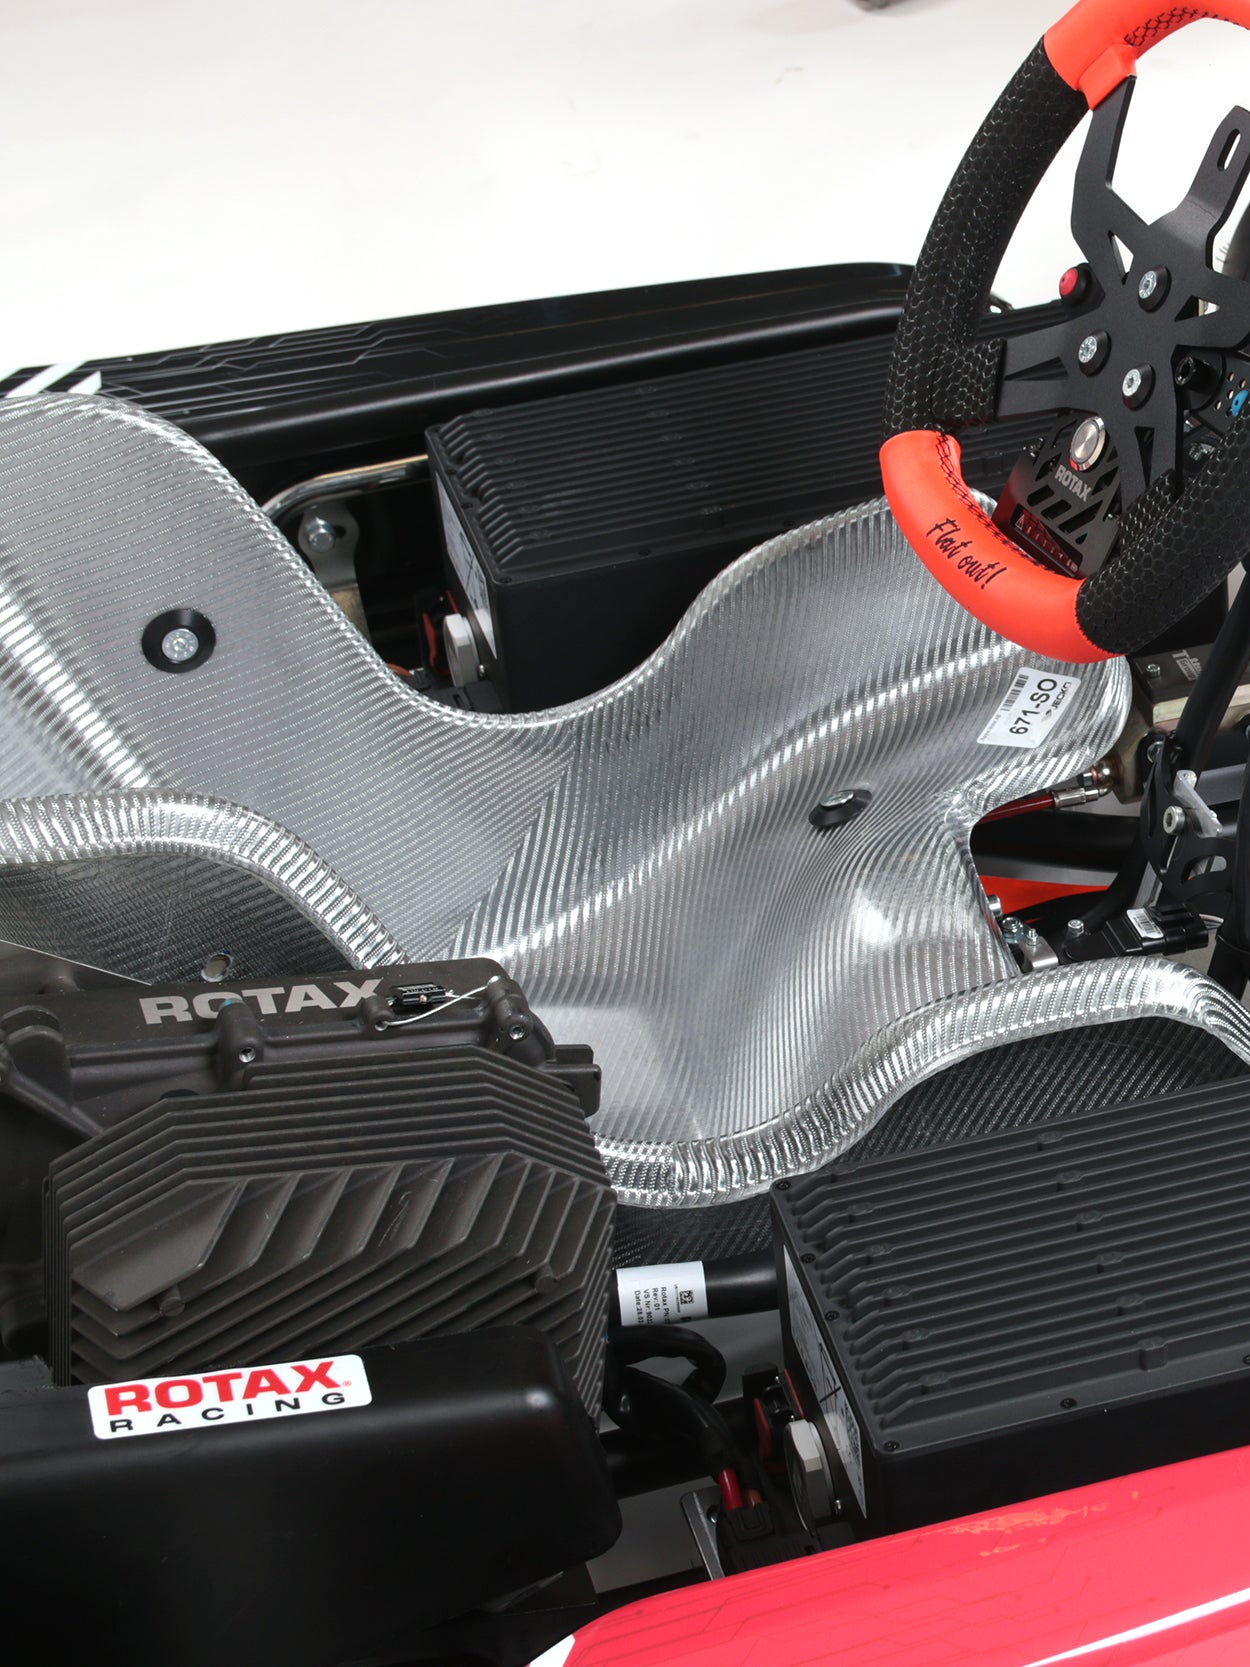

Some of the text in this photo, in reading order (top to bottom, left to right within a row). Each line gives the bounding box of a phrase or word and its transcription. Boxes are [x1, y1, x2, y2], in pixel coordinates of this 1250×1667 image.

[1054, 464, 1092, 502] ROTAX
[925, 518, 1007, 590] Flat out!
[1009, 678, 1058, 735] 671-SO
[138, 978, 385, 1025] ROTAX
[660, 1286, 669, 1306] Rotax
[104, 1361, 342, 1416] ROTAX
[110, 1392, 347, 1433] RACING
